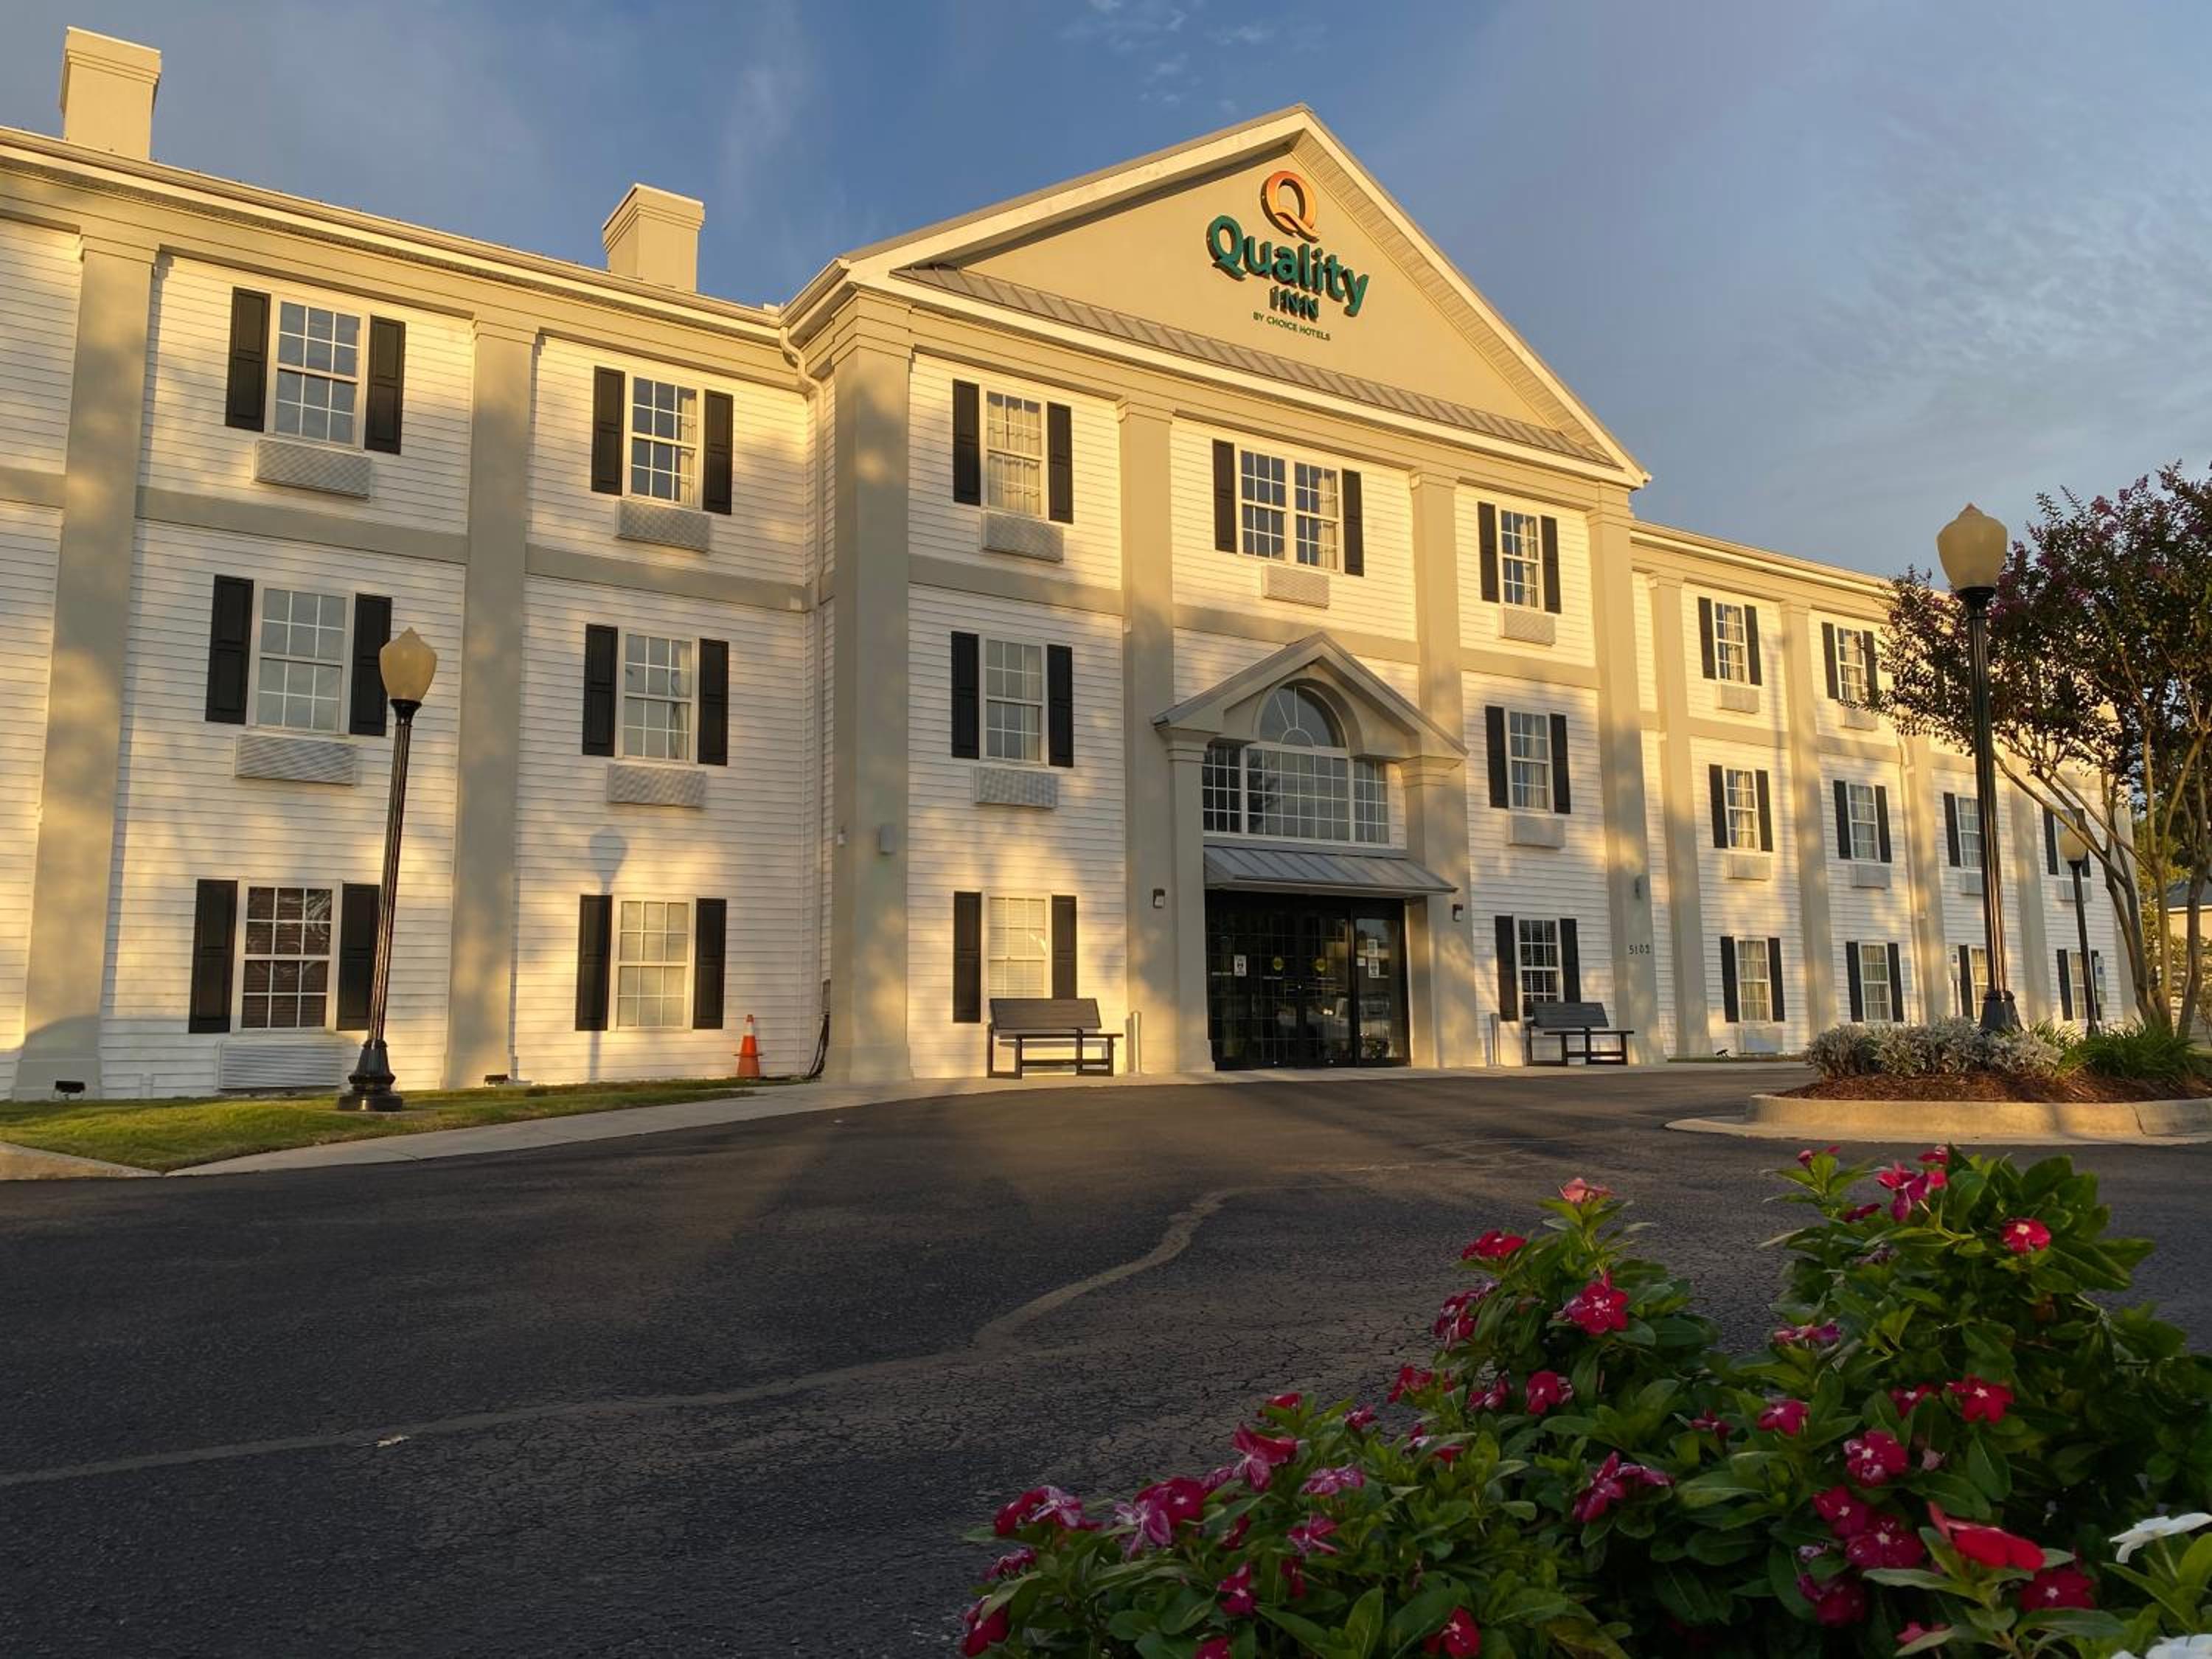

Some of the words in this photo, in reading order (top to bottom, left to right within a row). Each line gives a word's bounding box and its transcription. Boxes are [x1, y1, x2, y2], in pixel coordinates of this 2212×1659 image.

[1260, 170, 1321, 243] Q
[1206, 215, 1369, 317] Quality
[1253, 311, 1265, 321] BY
[1266, 316, 1298, 332] CHOICE
[1299, 325, 1331, 341] HOTELS
[1269, 285, 1319, 323] INN
